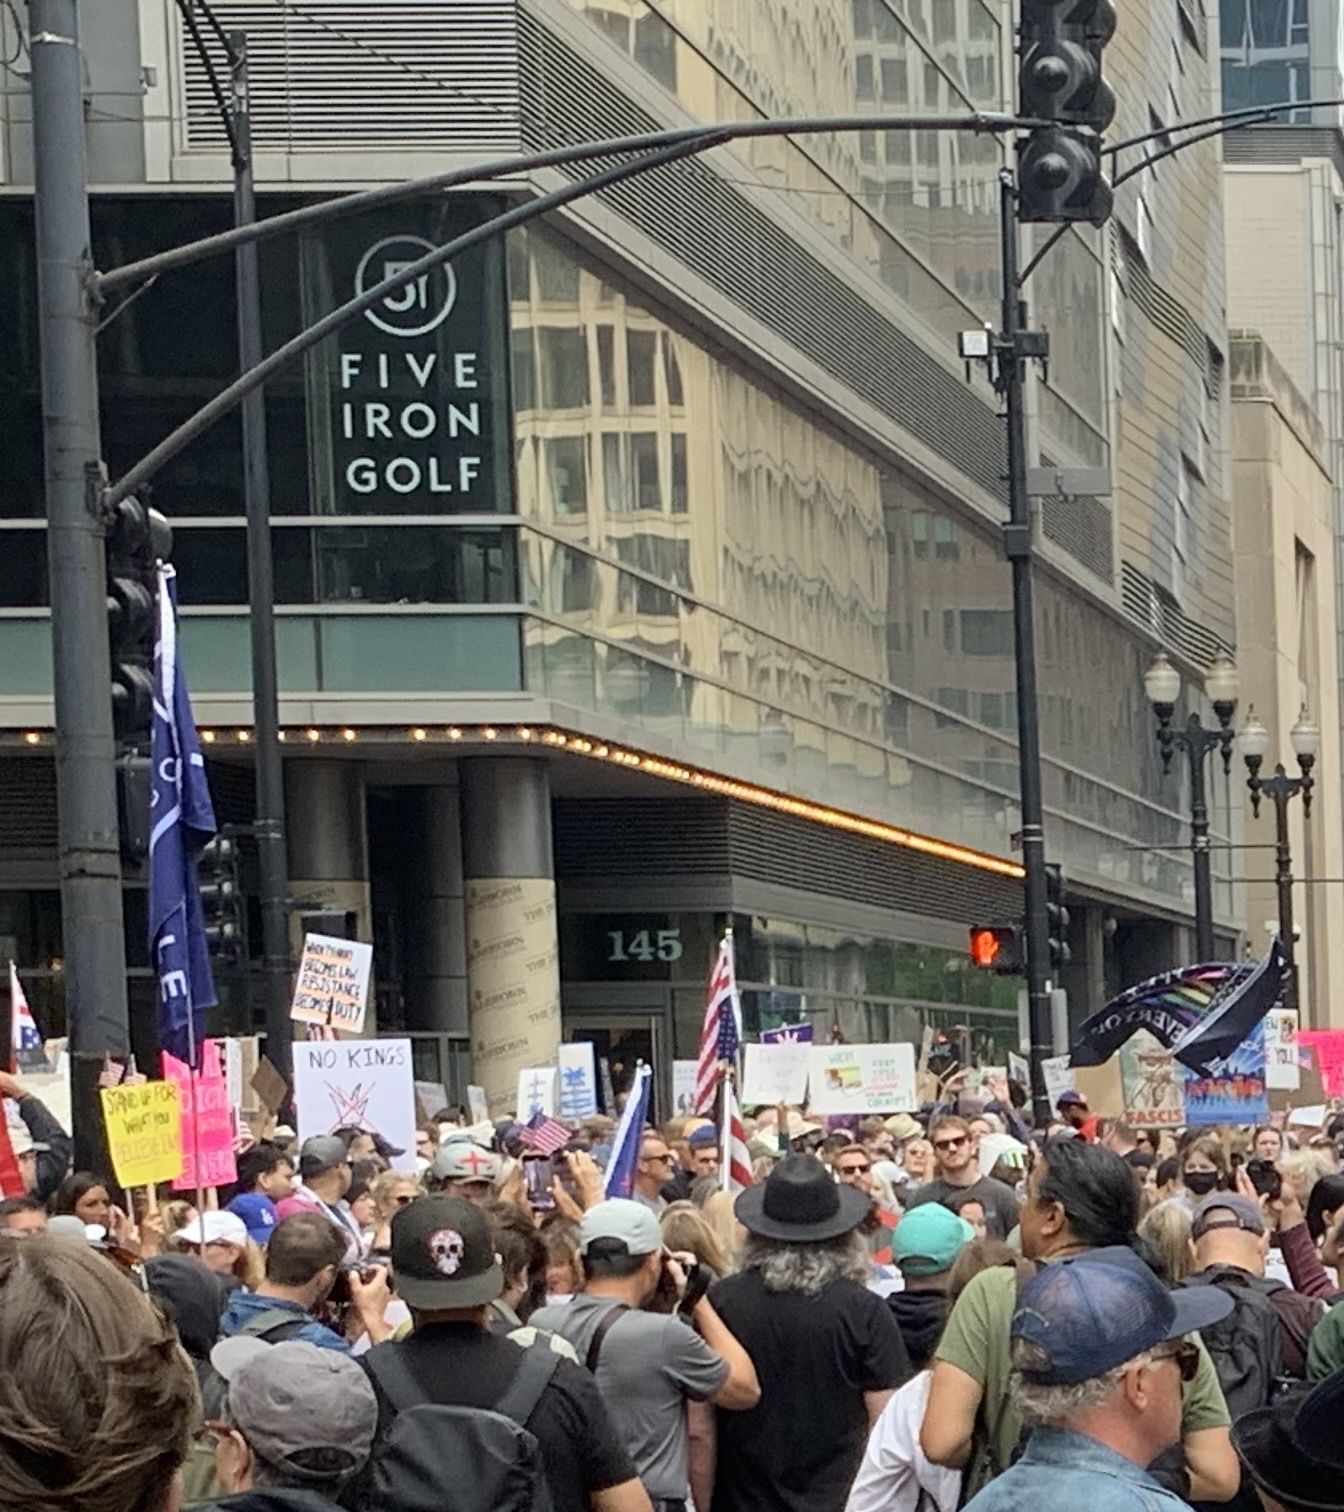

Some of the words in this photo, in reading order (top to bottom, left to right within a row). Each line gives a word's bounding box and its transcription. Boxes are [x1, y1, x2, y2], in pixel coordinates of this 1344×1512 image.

[341, 353, 477, 388] FIVE
[343, 402, 479, 438] IRON
[346, 457, 480, 493] GOLF
[608, 929, 683, 961] 145
[308, 1048, 337, 1069] NO
[347, 1046, 406, 1069] KINGS
